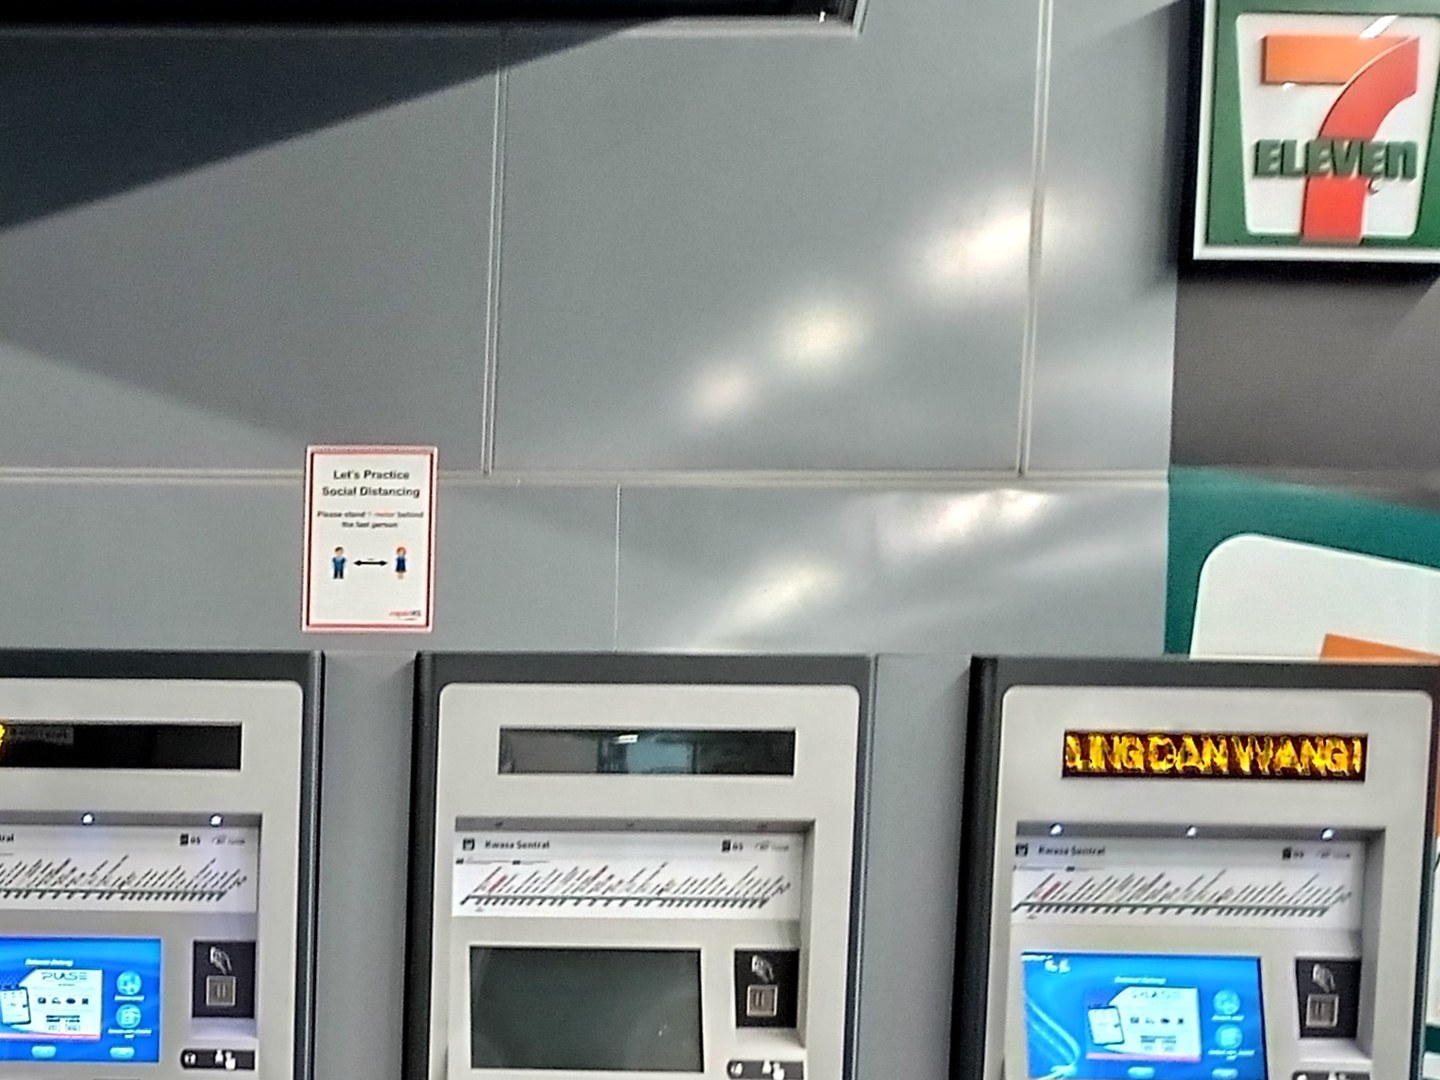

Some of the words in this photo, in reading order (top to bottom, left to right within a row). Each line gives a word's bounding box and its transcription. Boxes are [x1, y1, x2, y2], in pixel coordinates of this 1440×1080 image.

[1260, 34, 1420, 244] 7
[333, 469, 360, 480] Let's
[363, 469, 410, 480] Practice
[322, 486, 357, 497] Social
[359, 486, 420, 499] Distancing
